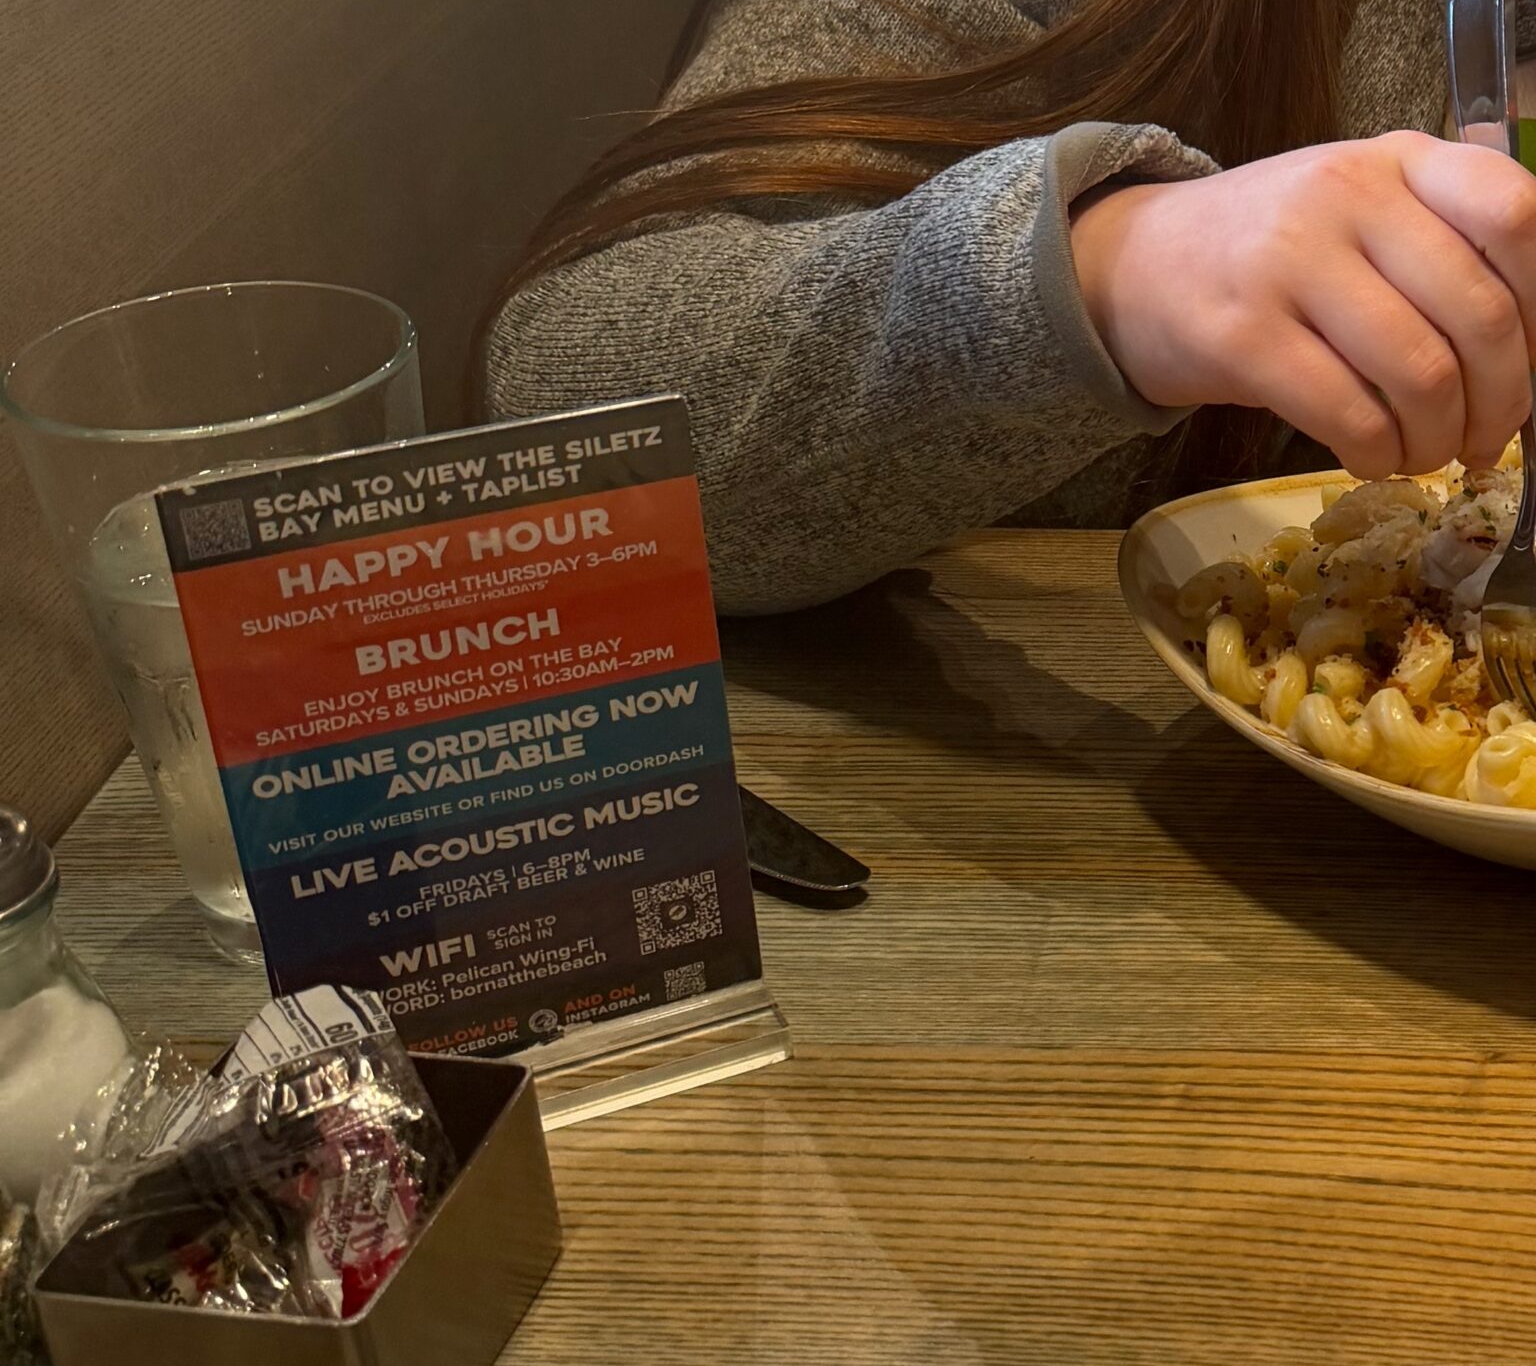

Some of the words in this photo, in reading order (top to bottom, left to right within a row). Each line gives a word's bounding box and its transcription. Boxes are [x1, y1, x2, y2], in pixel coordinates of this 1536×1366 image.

[253, 484, 342, 518] SCAN
[352, 475, 394, 499] TO
[403, 456, 486, 489] VIEW
[496, 445, 556, 472] THE
[565, 425, 662, 460] SILETZ
[258, 512, 321, 542] BAY
[332, 492, 425, 528] MENU
[436, 491, 453, 506] +
[461, 464, 582, 503] TAPLIST
[277, 536, 450, 599] HAPPY
[468, 507, 614, 561] HOUR
[242, 603, 340, 635] SUNDAY
[343, 580, 458, 615] THROUGH
[461, 554, 582, 589] THURSDAY
[363, 605, 431, 625] EXCLUDES
[432, 593, 479, 611] SELECT
[355, 608, 561, 676] BRUNCH
[304, 687, 380, 717] ENJOY
[386, 666, 485, 700] BRUNCH
[490, 658, 524, 677] ON
[529, 647, 573, 669] THE
[577, 637, 623, 658] BAY
[252, 748, 398, 800] ONLINE
[406, 704, 600, 765] ORDERING
[609, 680, 699, 722] NOW
[255, 705, 391, 747] SATURDAYS
[395, 702, 410, 718] &
[414, 678, 519, 713] SUNDAYS
[268, 833, 317, 855] VISIT
[323, 823, 365, 842] OUR
[369, 803, 453, 831] WEBSITE
[458, 795, 485, 812] OR
[490, 784, 534, 804] FIND
[539, 778, 564, 793] US
[569, 769, 598, 786] ON
[602, 744, 704, 779] DOORDASH
[387, 734, 586, 800] AVAILABLE
[291, 856, 379, 899] LIVE
[388, 812, 577, 876] ACOUSTIC
[584, 783, 700, 831] MUSIC
[367, 909, 391, 928] $1
[396, 897, 437, 919] OFF
[443, 881, 511, 909] DRAFT
[517, 867, 569, 891] BEER
[574, 862, 588, 877] &
[593, 848, 646, 871] WINE
[419, 868, 506, 900] FRIDAYS
[379, 933, 477, 977] WIFI
[486, 921, 531, 941] SCAN
[535, 915, 557, 927] TO
[494, 933, 533, 951] SIGN
[536, 928, 554, 940] IN
[442, 960, 515, 988] Pelican
[519, 937, 596, 968] Wing-Fi
[451, 950, 608, 1001] bornatthebeach
[493, 1016, 519, 1031] US
[563, 993, 604, 1014] AND
[609, 984, 637, 1000] ON
[565, 993, 651, 1025] INSTAGRAM
